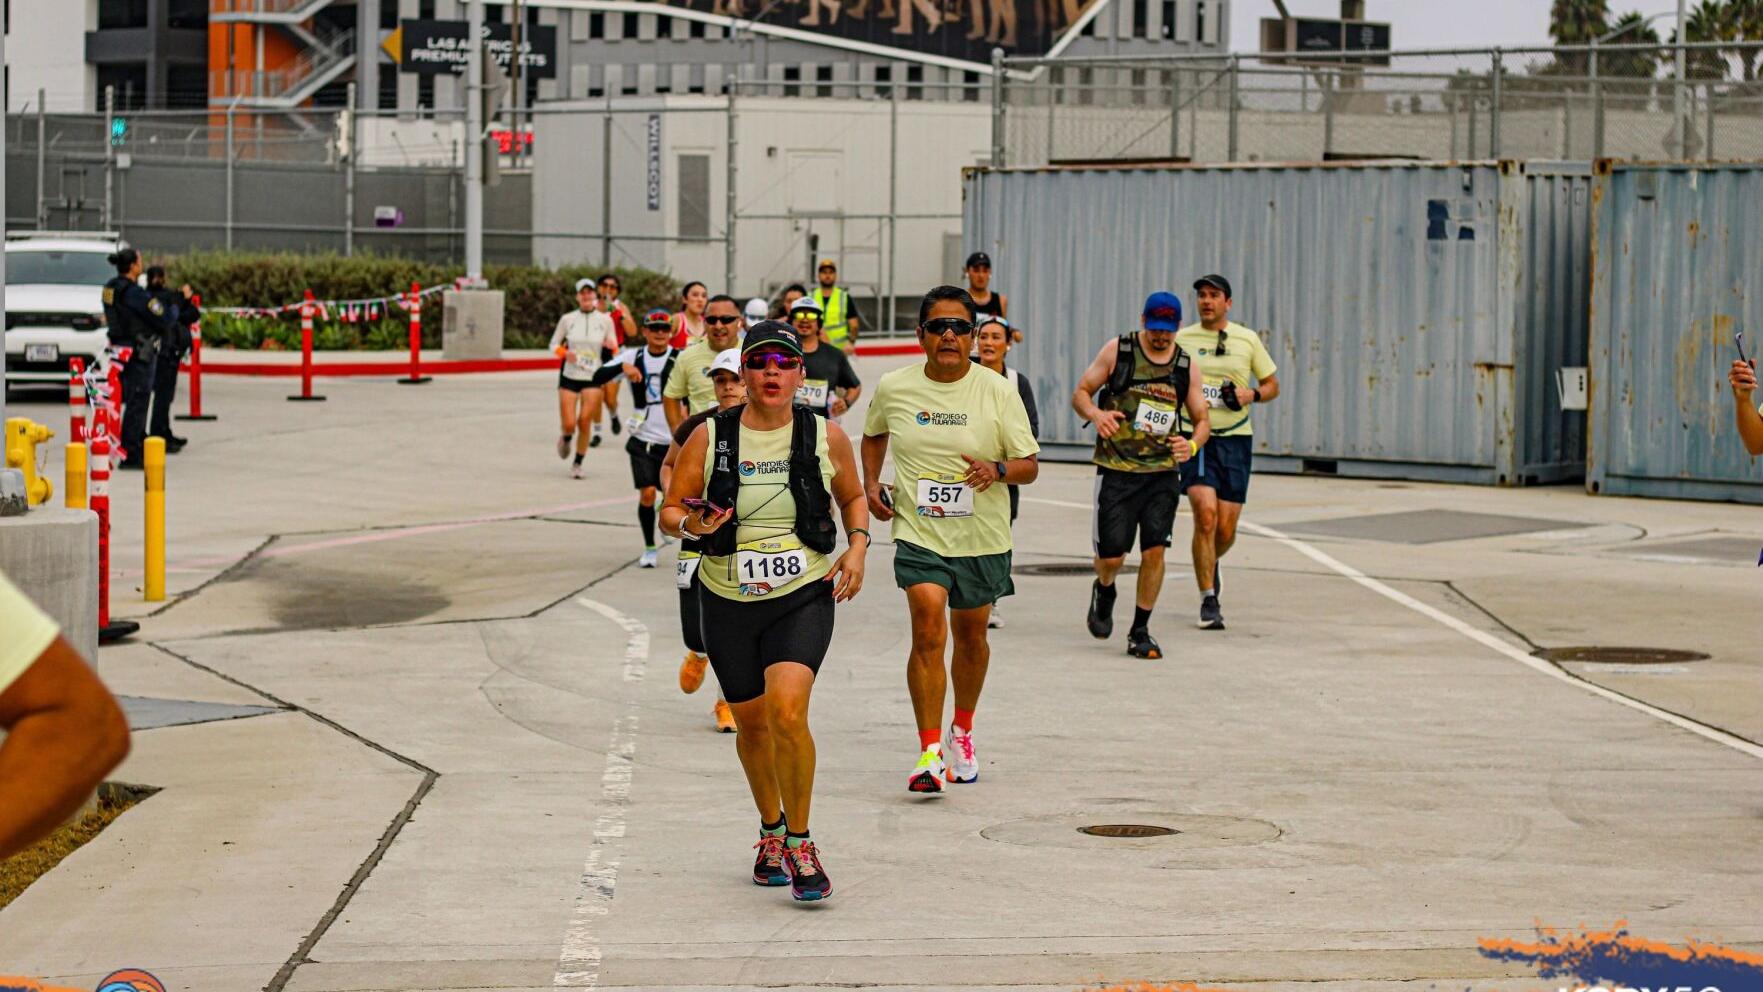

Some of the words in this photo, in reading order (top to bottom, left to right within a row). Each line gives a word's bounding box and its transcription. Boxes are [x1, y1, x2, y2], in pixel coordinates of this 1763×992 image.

[427, 37, 456, 50] LAS
[1144, 410, 1169, 425] 486
[928, 486, 963, 503] 557
[743, 555, 801, 578] 1188
